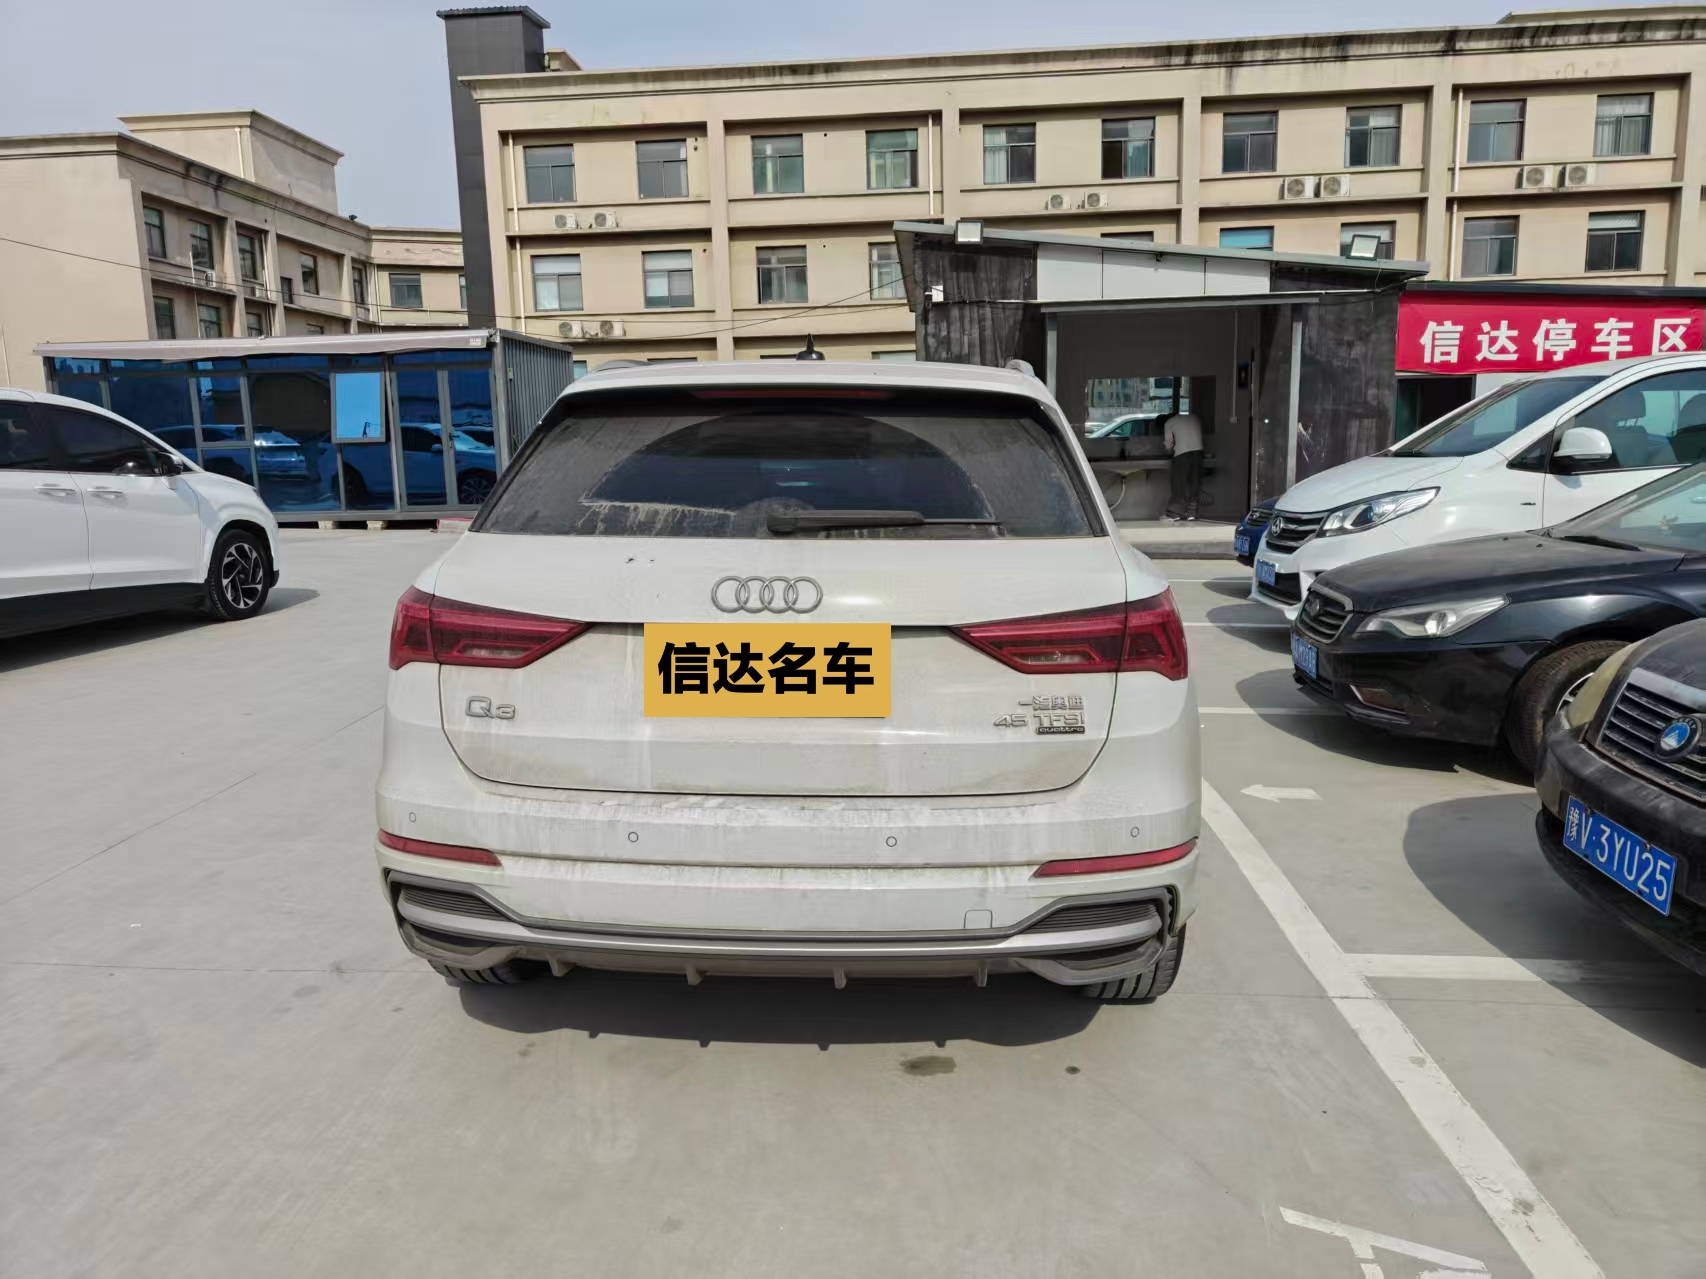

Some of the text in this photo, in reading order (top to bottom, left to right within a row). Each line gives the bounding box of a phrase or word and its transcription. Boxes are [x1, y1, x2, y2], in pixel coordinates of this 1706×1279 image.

[1419, 317, 1692, 364] 信达停车区
[465, 696, 516, 719] Q3
[994, 712, 1085, 727] 45 TFSI
[1039, 726, 1084, 734] quattro
